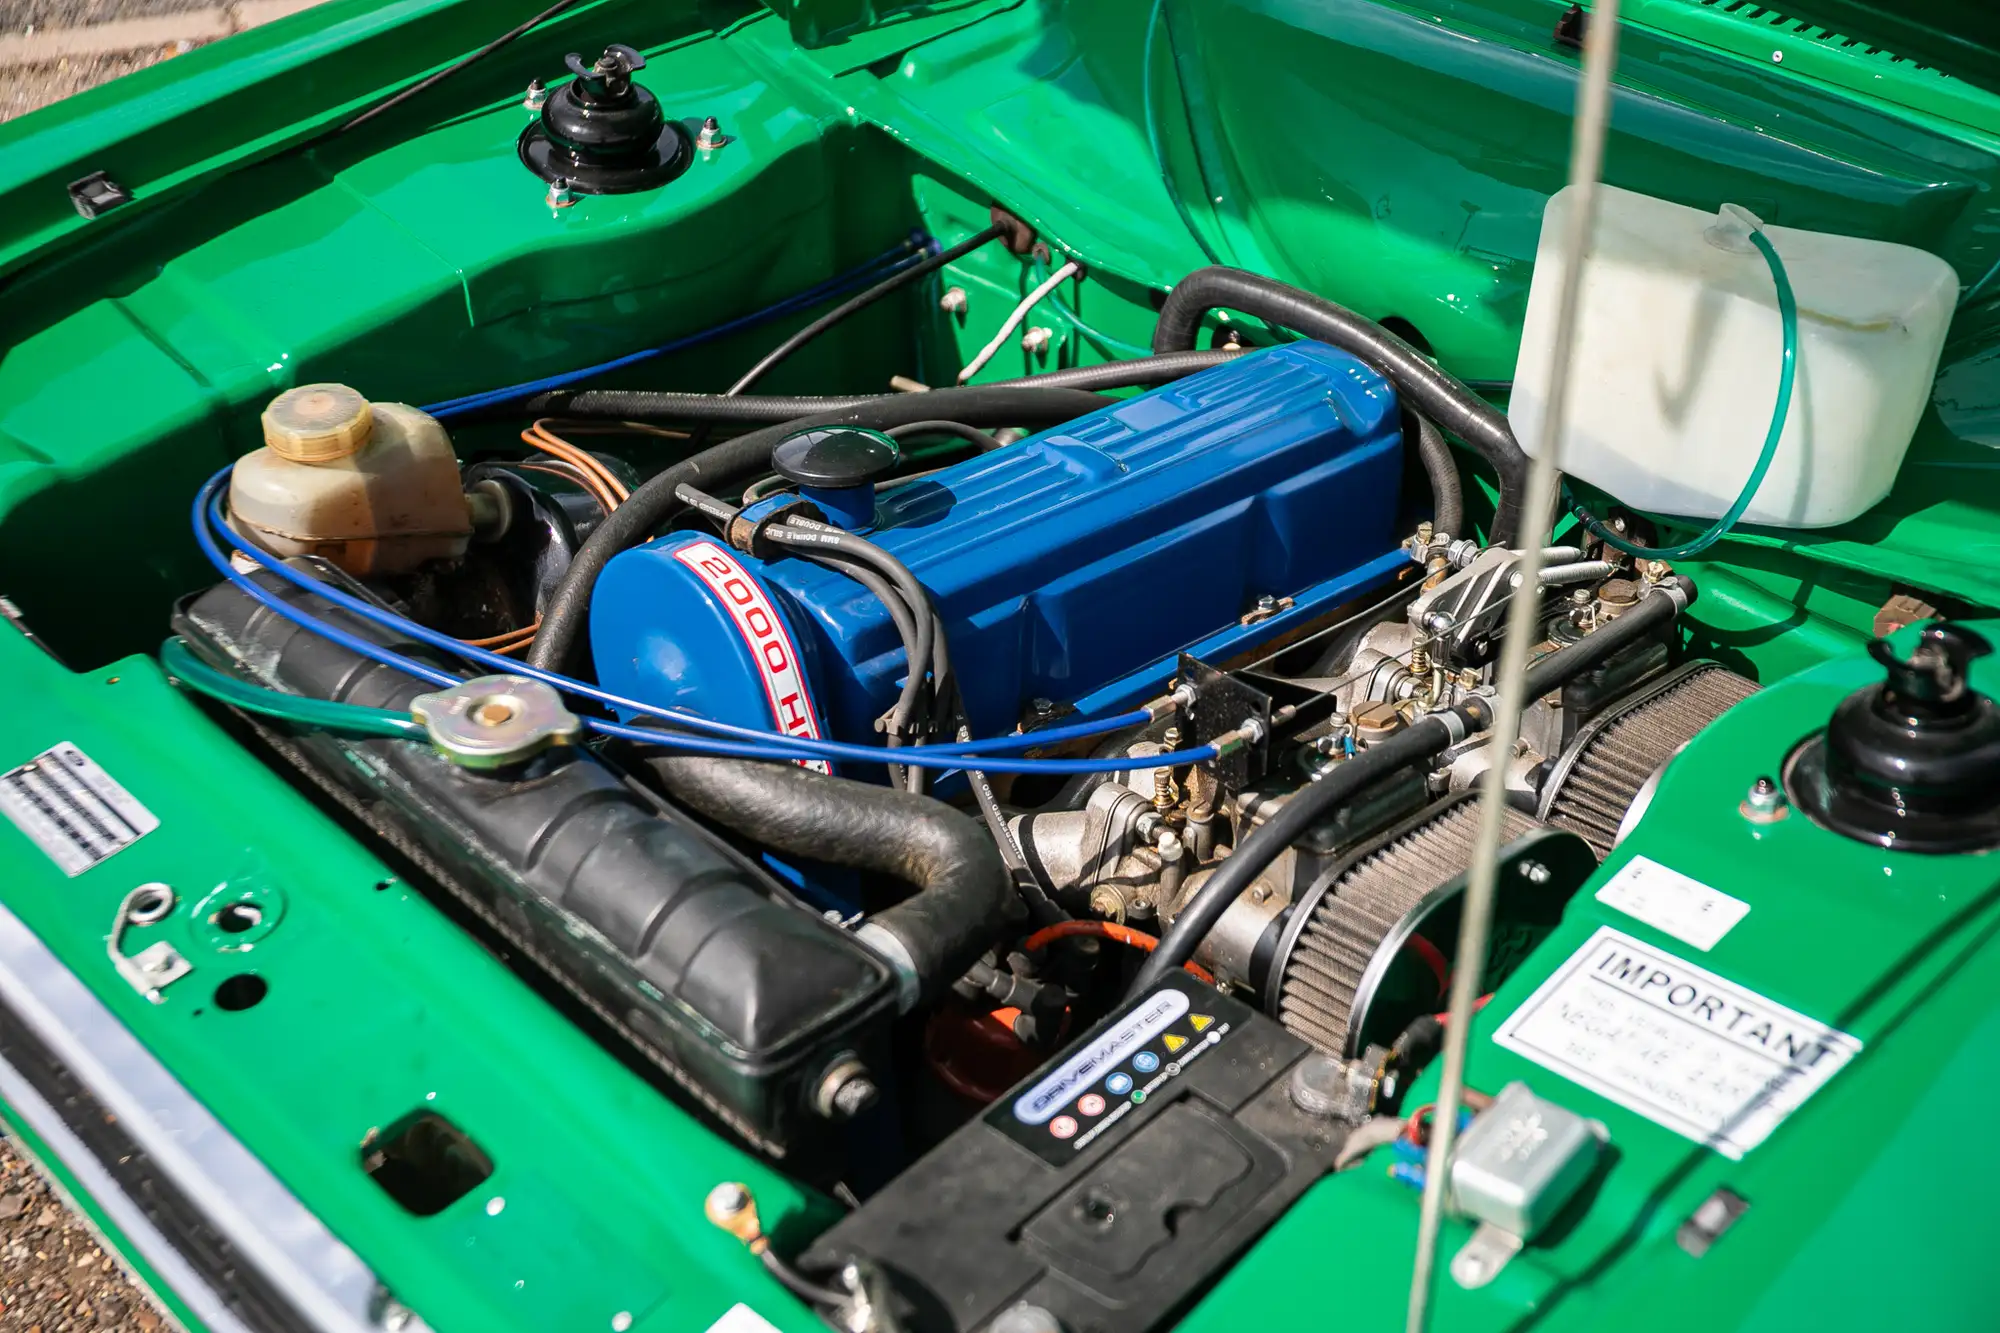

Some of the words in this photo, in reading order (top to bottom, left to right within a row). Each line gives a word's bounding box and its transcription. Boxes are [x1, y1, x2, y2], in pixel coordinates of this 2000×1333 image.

[700, 557, 788, 669] 2000
[1032, 1000, 1173, 1112] DRIVEMASTER
[1597, 951, 1838, 1067] IMPORTANT
